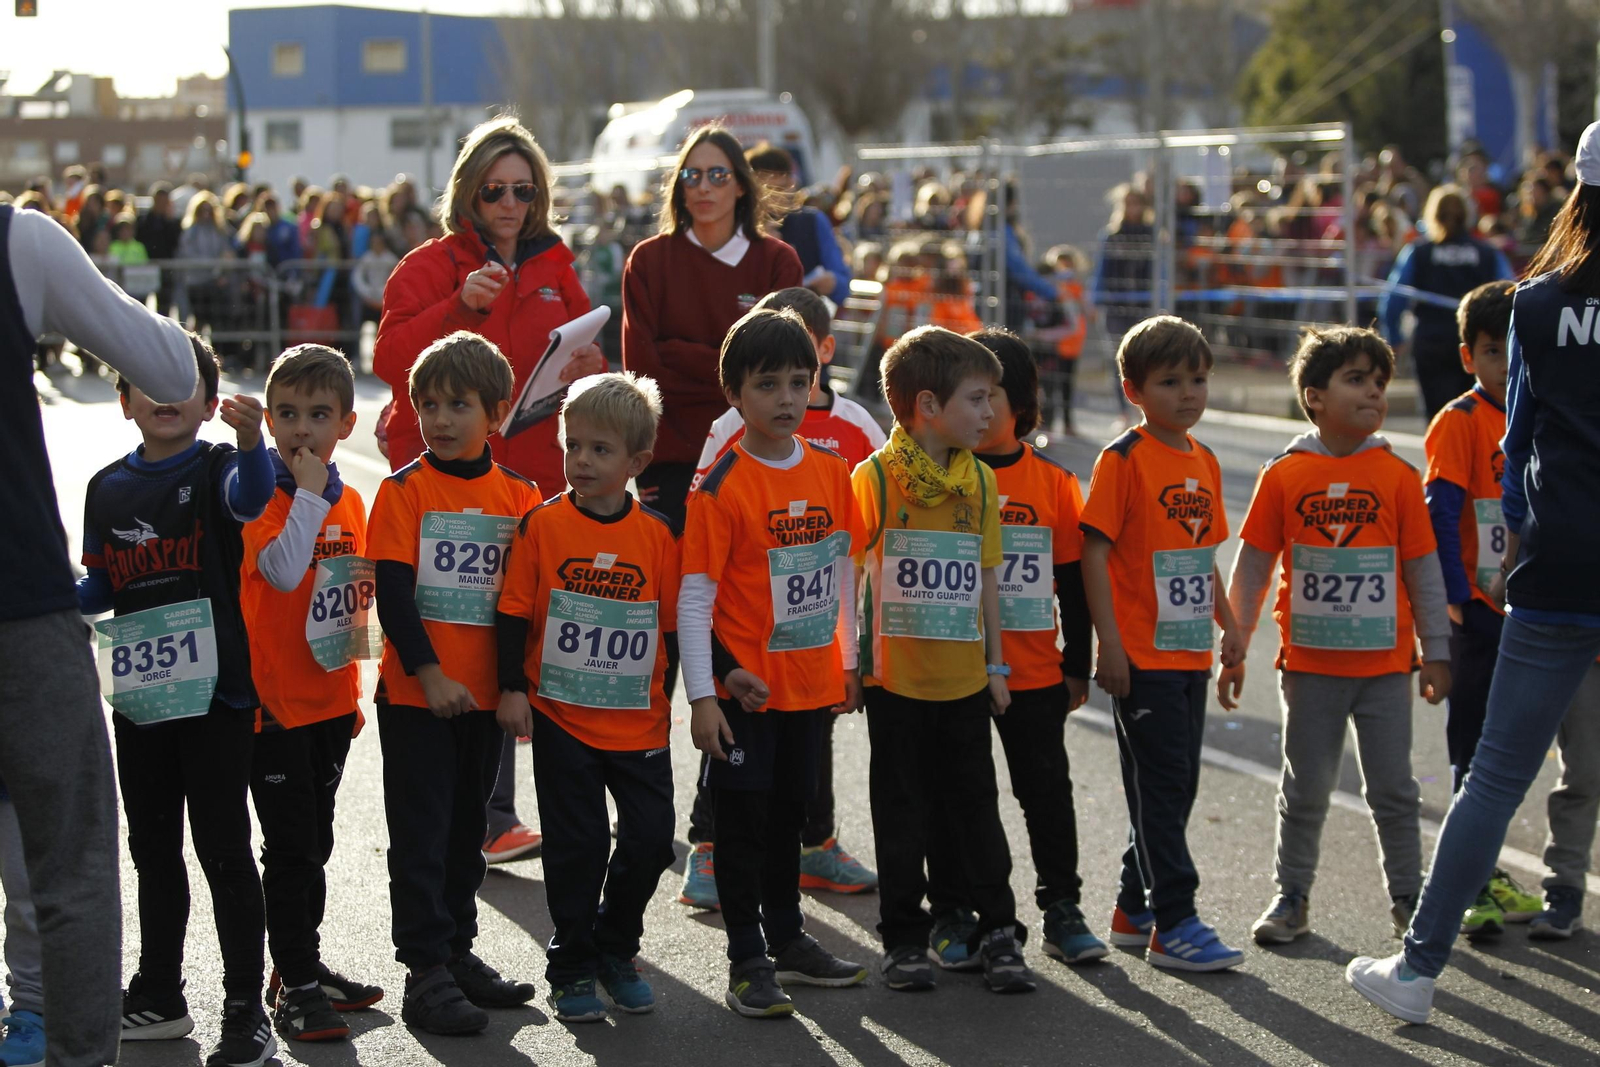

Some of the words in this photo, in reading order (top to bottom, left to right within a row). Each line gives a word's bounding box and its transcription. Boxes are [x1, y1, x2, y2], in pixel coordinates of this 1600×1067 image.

[1310, 498, 1370, 513] SUPER
[775, 516, 827, 532] SUPER
[1304, 511, 1378, 527] RUNNER
[1491, 525, 1506, 553] 8
[572, 567, 634, 586] SUPER
[897, 558, 977, 592] 8009
[1003, 554, 1040, 583] 75
[128, 581, 147, 589] CLUB
[147, 576, 181, 586] DEPORTIV
[459, 575, 495, 586] MANUEL
[787, 562, 836, 606] 847
[1303, 573, 1386, 603] 8273
[902, 590, 934, 599] HIJITO
[937, 591, 972, 601] GUAPITO!
[1169, 574, 1214, 606] 837
[312, 581, 375, 622] 8208
[787, 599, 827, 616] FRANCISCO
[1333, 604, 1352, 612] ROD
[164, 607, 202, 620] CARRERA
[574, 612, 599, 620] ALMERÍA
[575, 607, 602, 615] MARATÓN
[167, 617, 203, 628] INFANTIL
[337, 617, 352, 628] ALEX
[557, 622, 649, 661] 8100
[112, 630, 199, 677] 8351
[584, 659, 618, 669] JAVIER
[140, 669, 172, 683] JORGE
